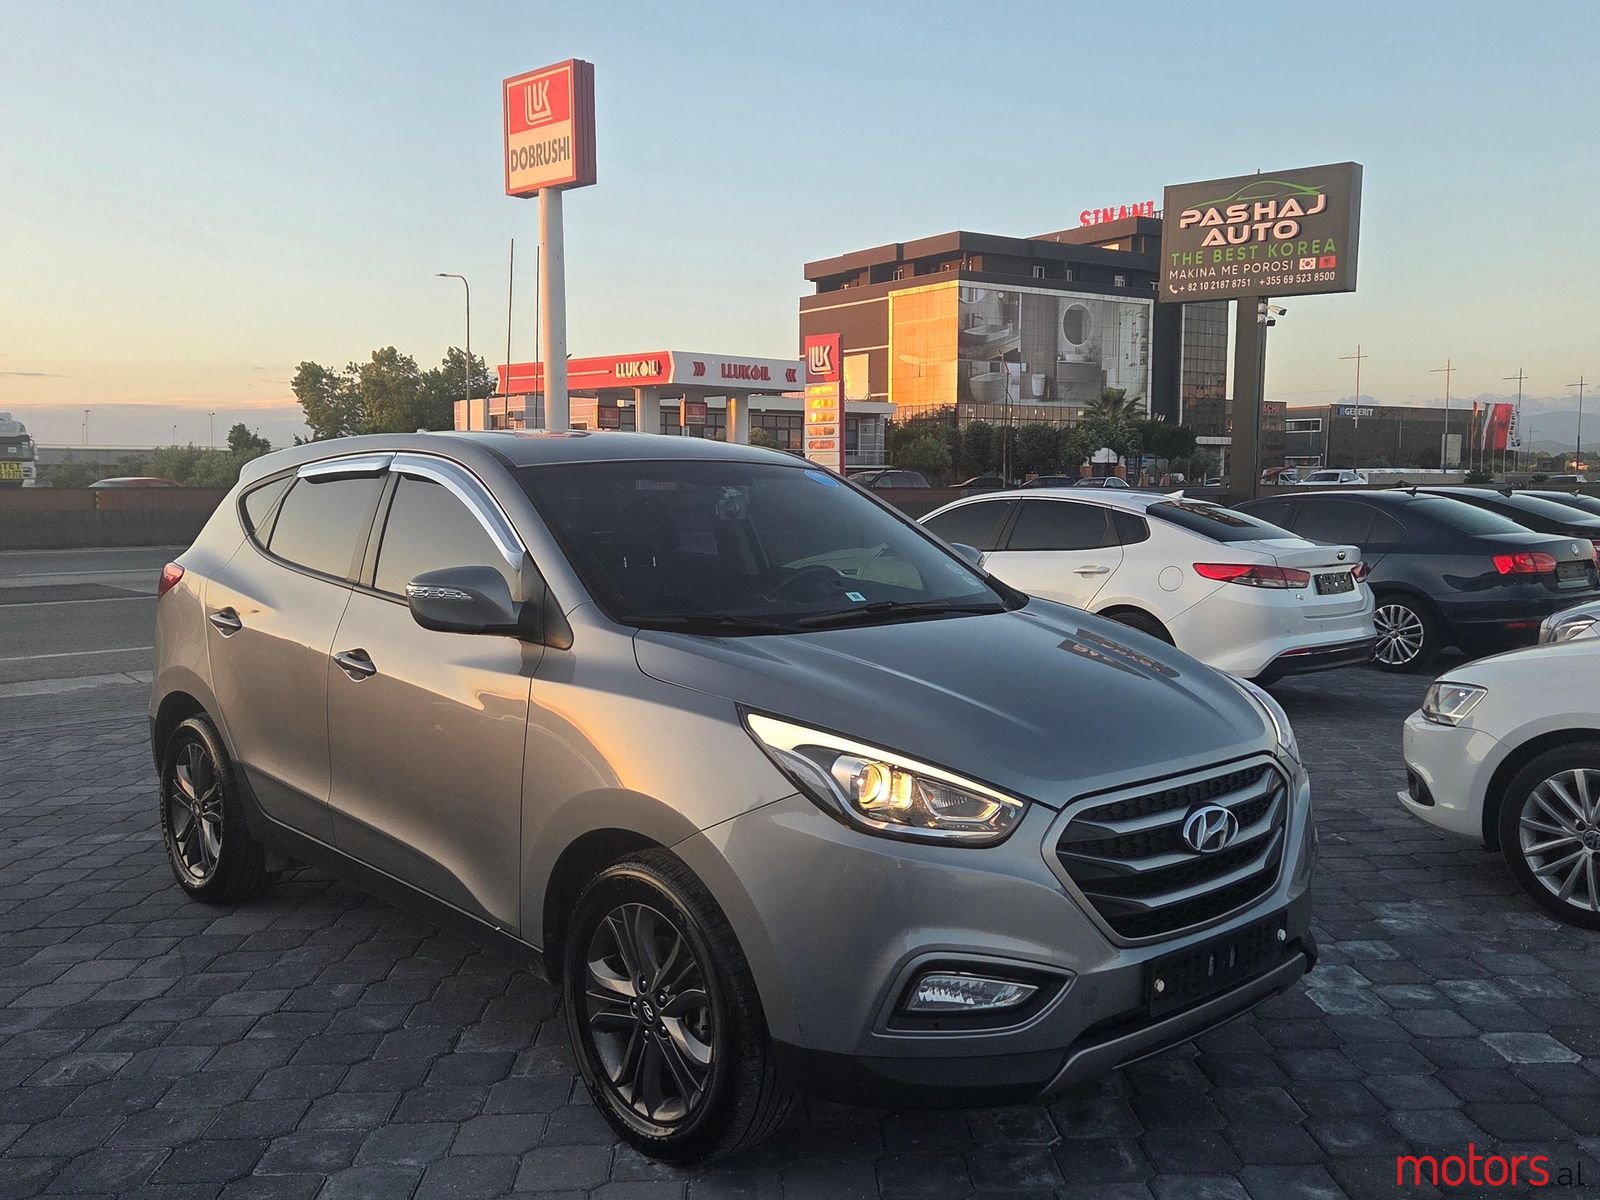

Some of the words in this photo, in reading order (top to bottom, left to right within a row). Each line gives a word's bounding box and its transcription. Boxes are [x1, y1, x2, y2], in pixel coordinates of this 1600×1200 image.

[510, 135, 570, 172] DOBRUSHI
[1179, 194, 1327, 229] PASHAJ
[1201, 220, 1299, 247] AUTO
[1171, 251, 1204, 267] THE
[1213, 245, 1258, 263] BEST
[1268, 238, 1336, 258] KOREA
[1169, 266, 1216, 280] MAKINA
[1221, 265, 1238, 276] ME
[1244, 260, 1293, 274] POROSI
[1188, 282, 1197, 292] 82
[1200, 282, 1209, 291] 10
[1211, 280, 1230, 290] 2187
[1232, 278, 1251, 288] 8751
[1259, 275, 1281, 286] +355
[1283, 274, 1293, 284] 69
[1296, 273, 1312, 283] 523
[1314, 271, 1335, 282] 8500
